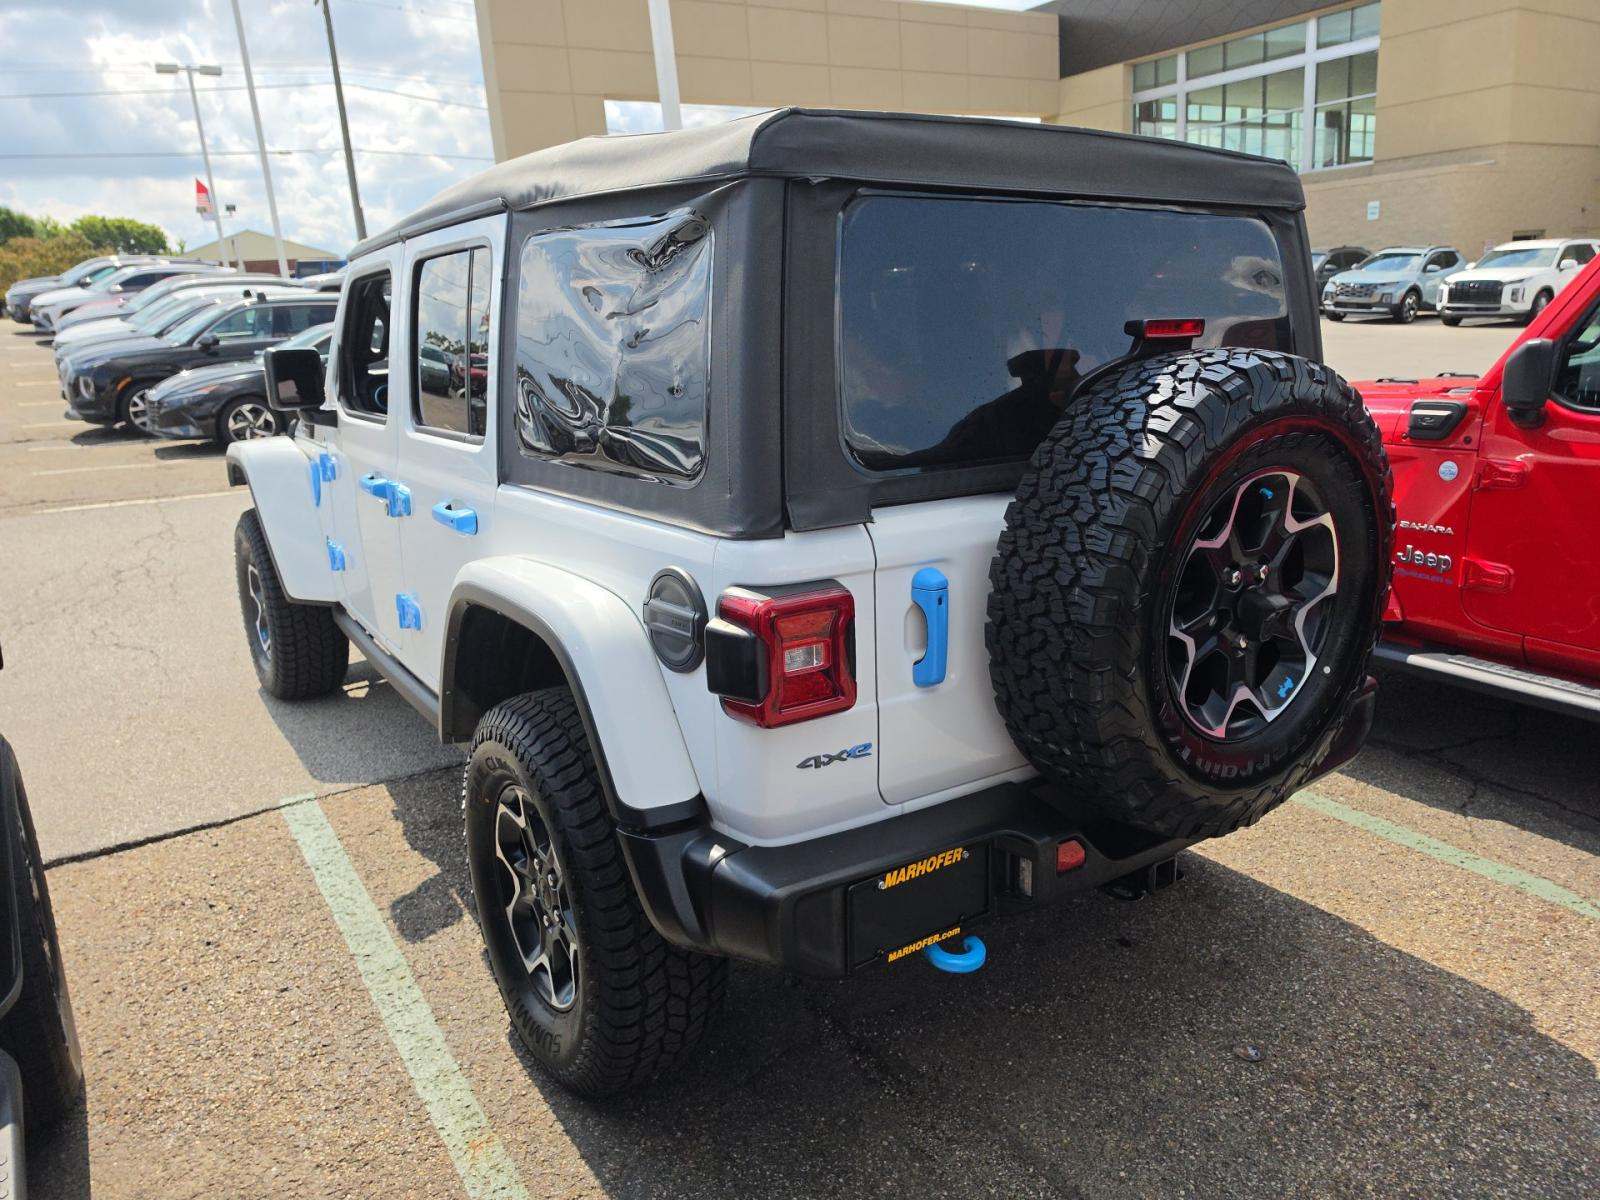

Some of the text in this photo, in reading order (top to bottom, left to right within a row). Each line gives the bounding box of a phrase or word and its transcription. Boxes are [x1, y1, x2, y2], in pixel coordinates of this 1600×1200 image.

[1399, 520, 1454, 535] SAHARA
[1396, 544, 1452, 573] Jeep
[884, 847, 964, 889] MARHOFER
[887, 926, 961, 963] MARHOFER.com
